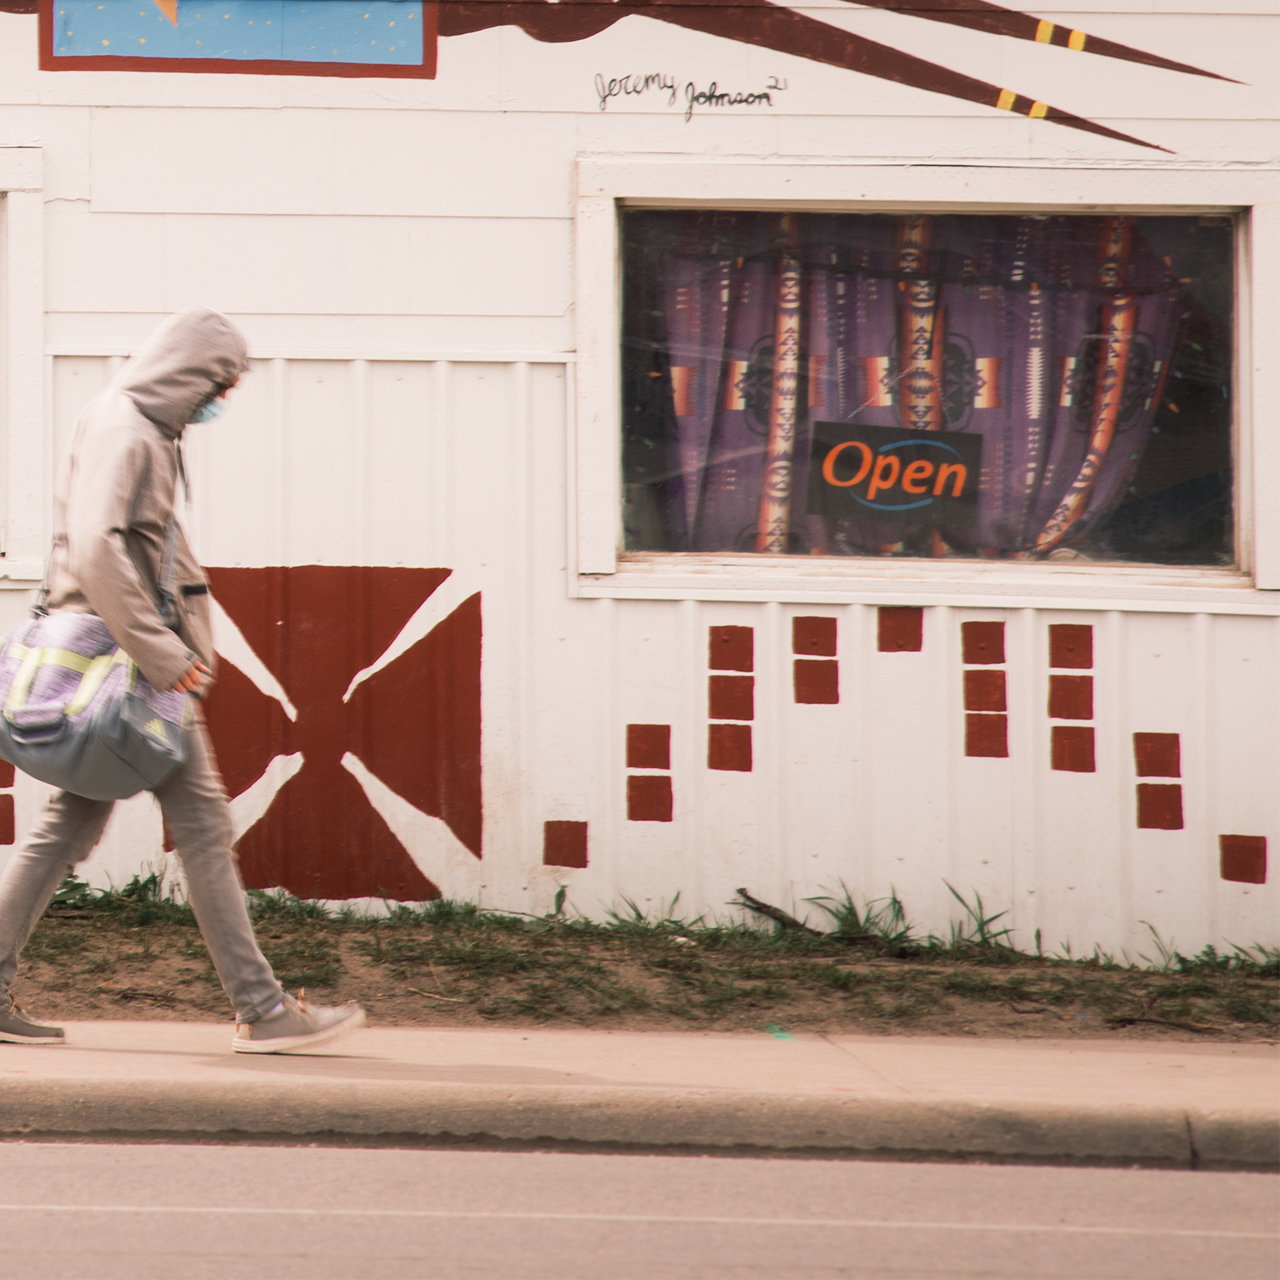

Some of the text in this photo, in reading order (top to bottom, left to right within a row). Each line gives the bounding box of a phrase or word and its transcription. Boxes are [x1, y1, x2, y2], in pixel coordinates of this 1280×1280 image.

[595, 72, 676, 111] Jeremy
[685, 81, 773, 123] Johnson
[822, 441, 967, 499] Open
